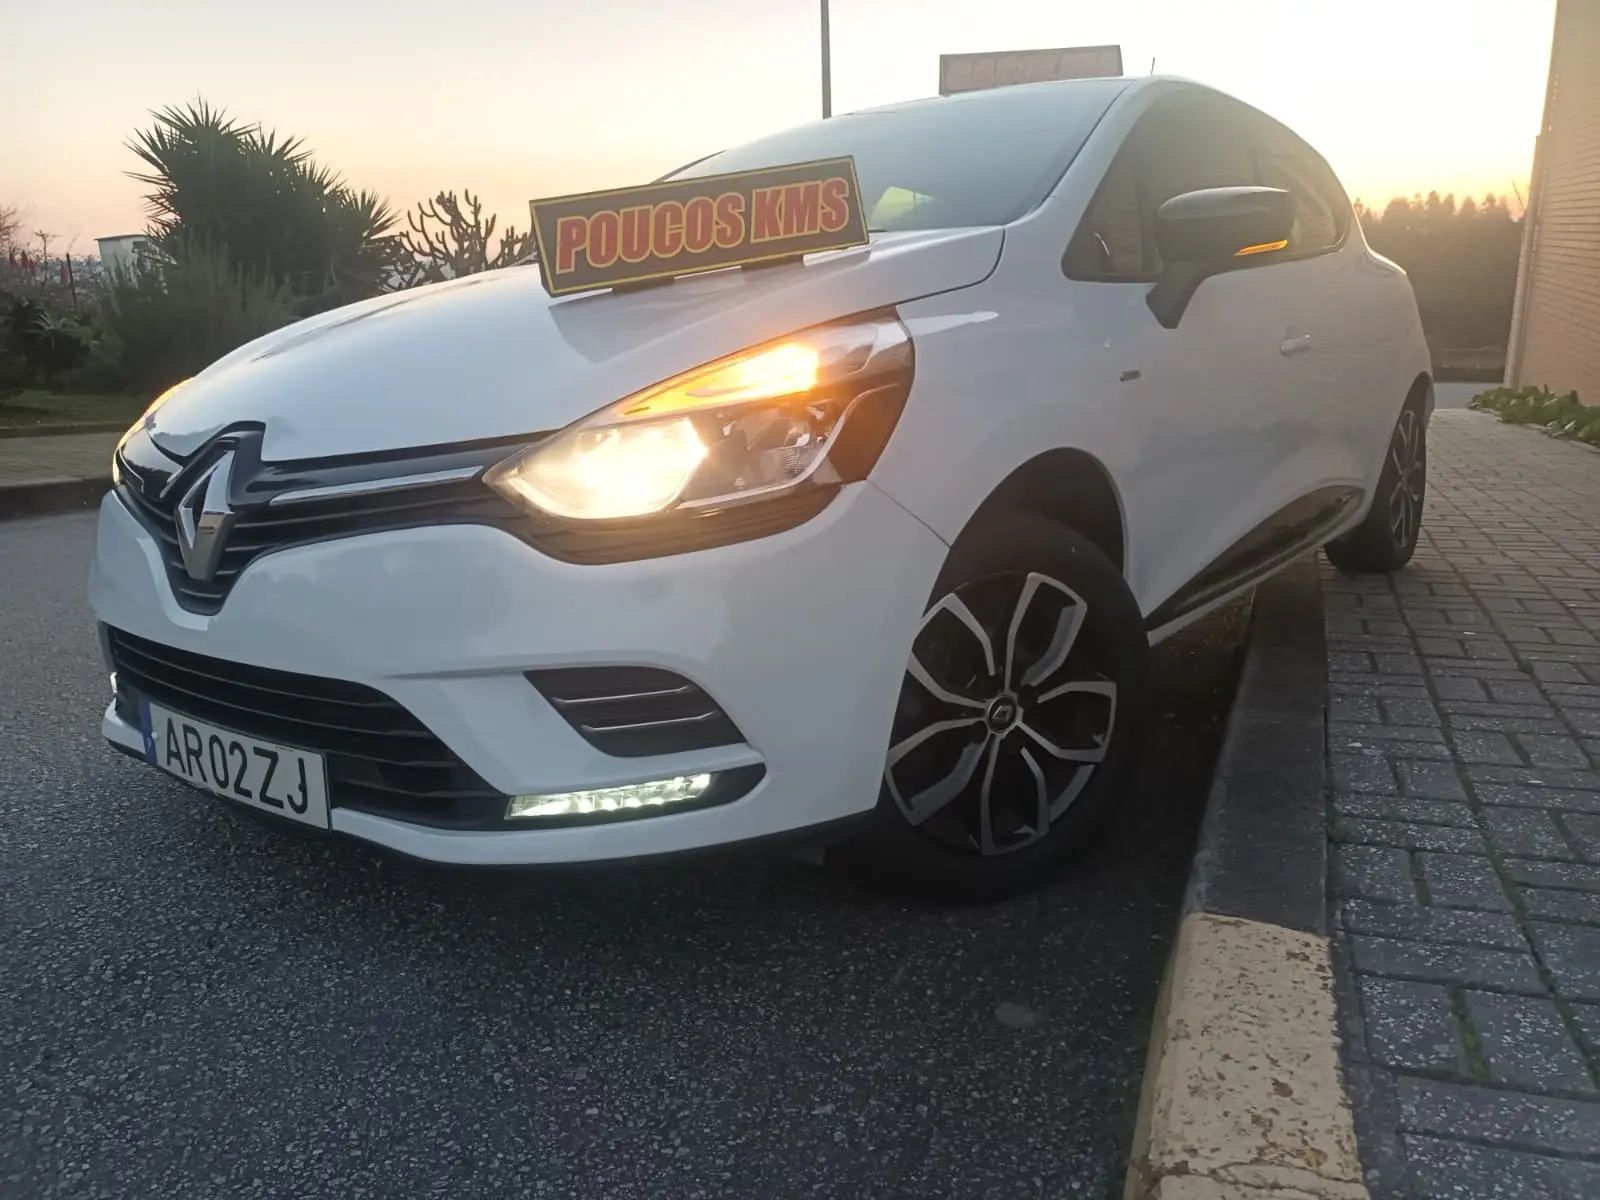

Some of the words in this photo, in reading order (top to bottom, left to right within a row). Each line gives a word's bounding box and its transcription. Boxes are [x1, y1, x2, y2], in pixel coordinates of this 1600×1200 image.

[556, 193, 744, 274] POUCOS
[751, 178, 849, 243] KMS
[166, 717, 308, 814] AR02ZJ
